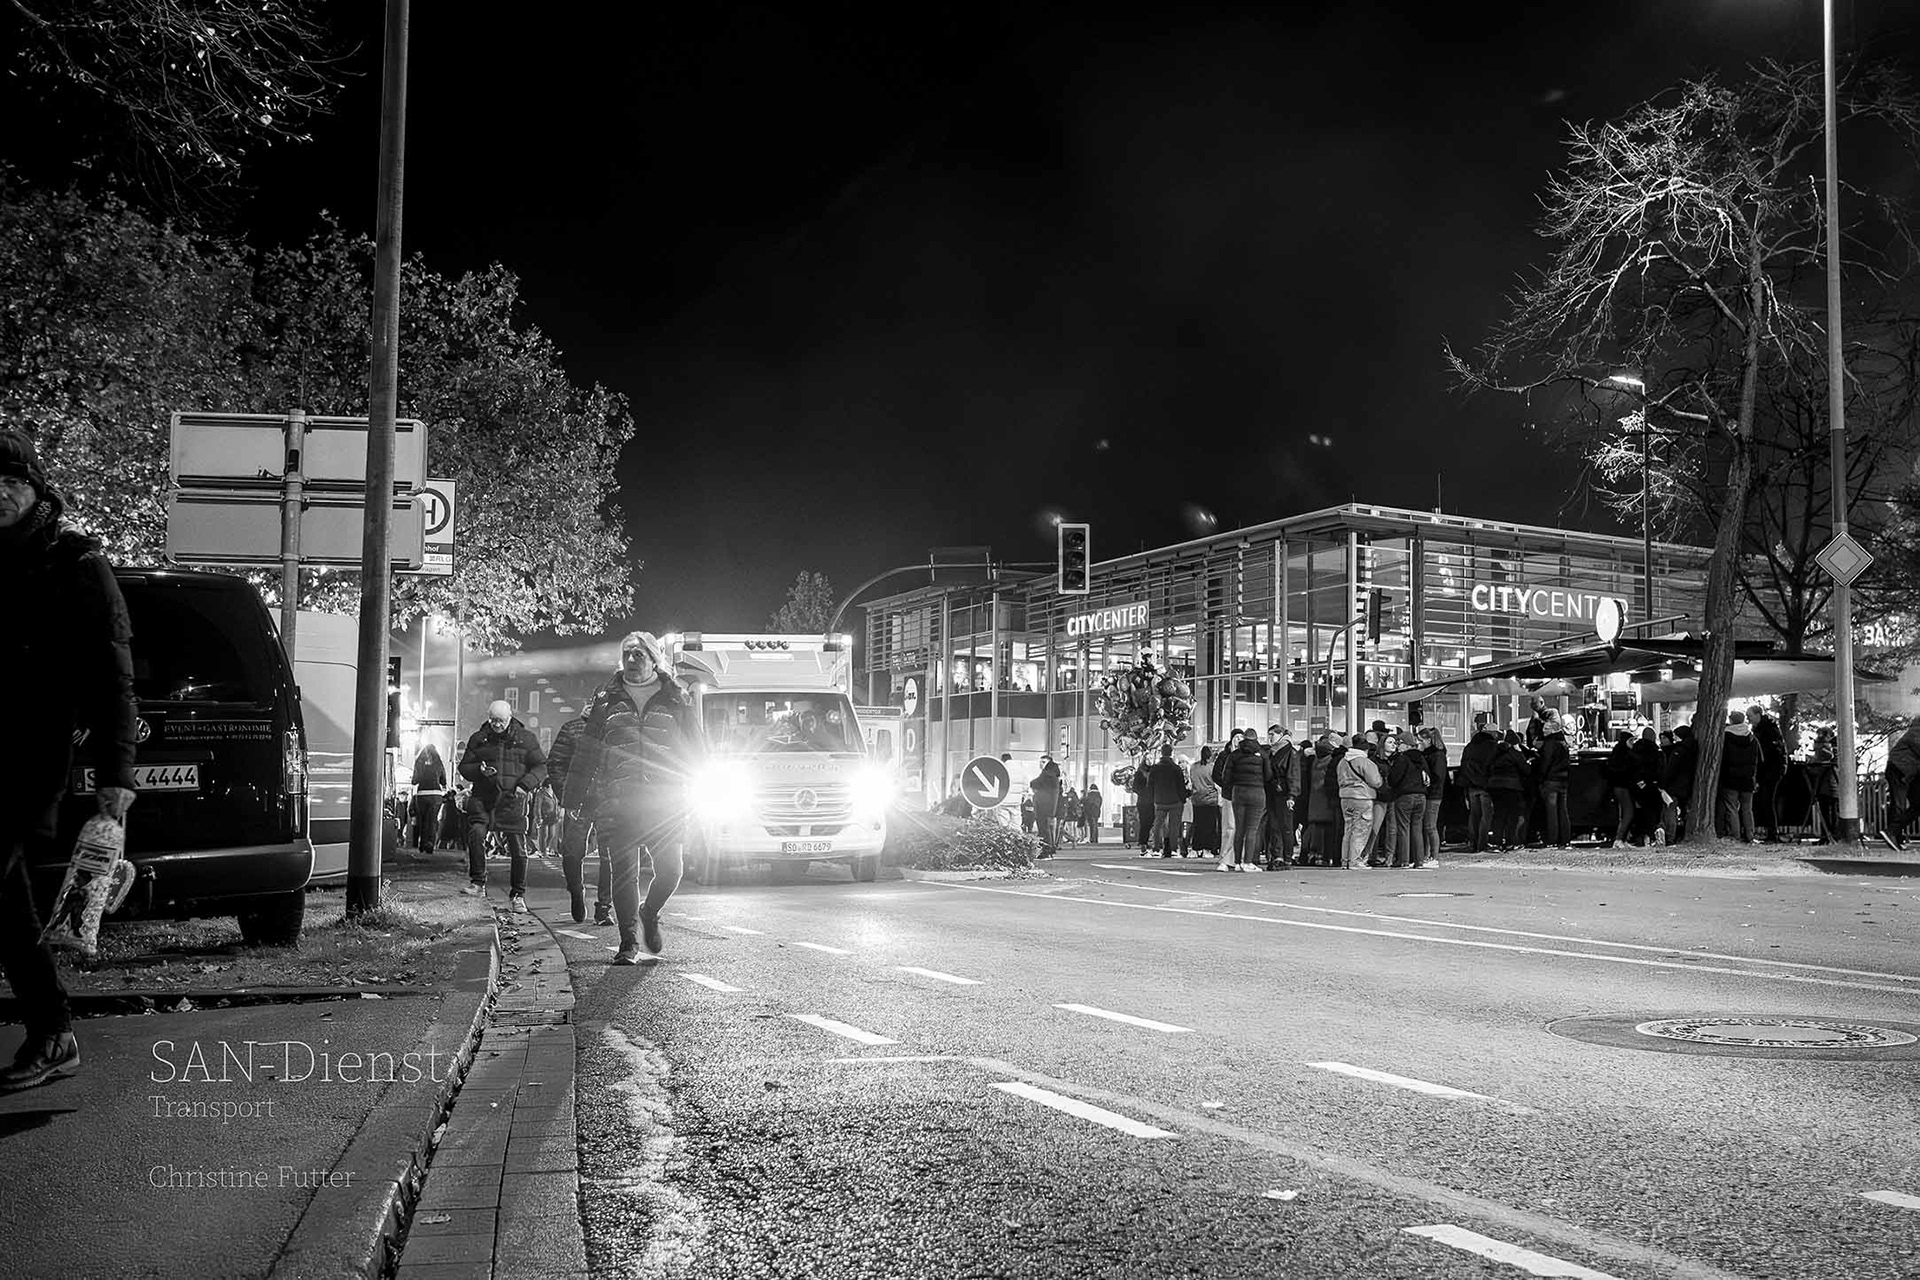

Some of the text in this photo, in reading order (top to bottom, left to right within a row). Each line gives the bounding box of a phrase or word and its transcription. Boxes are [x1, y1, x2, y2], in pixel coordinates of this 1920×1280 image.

[1472, 584, 1629, 626] CITYCENTR
[1067, 605, 1147, 636] CITYCENTER
[146, 767, 196, 786] 4444
[813, 842, 832, 851] 6679
